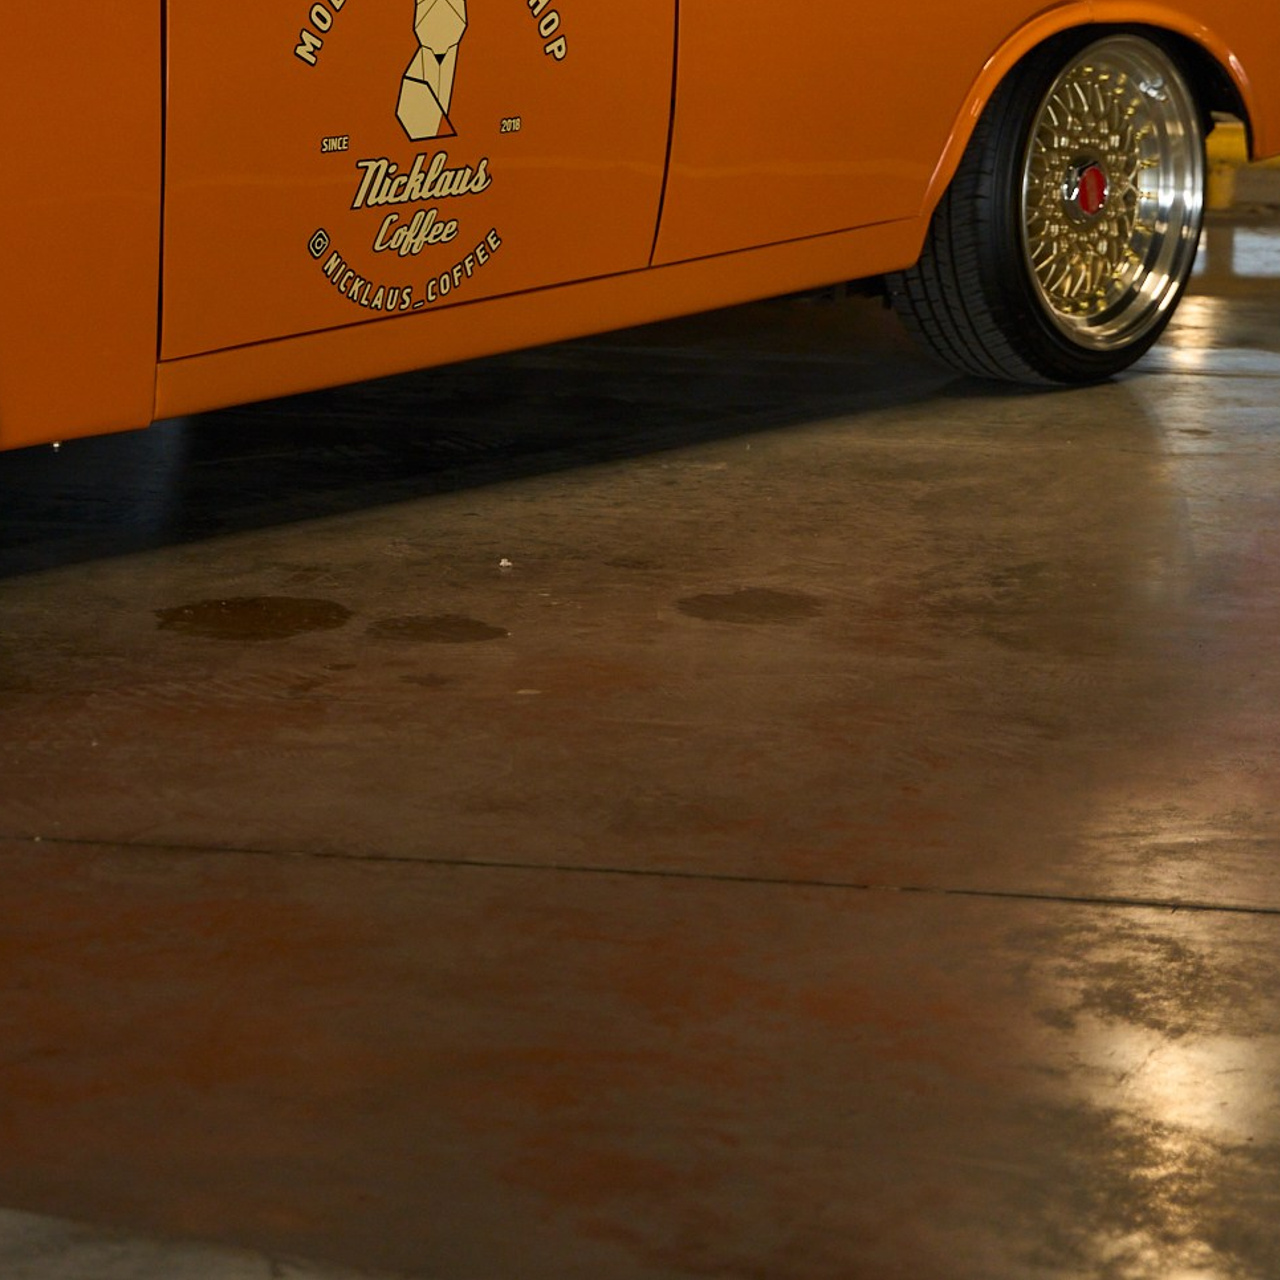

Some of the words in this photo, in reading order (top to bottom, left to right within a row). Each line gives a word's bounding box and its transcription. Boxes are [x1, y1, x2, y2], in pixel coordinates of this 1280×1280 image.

[500, 117, 521, 134] 2018
[321, 135, 349, 153] SINCE
[350, 151, 492, 210] Nicklaus
[373, 208, 459, 257] Coffee
